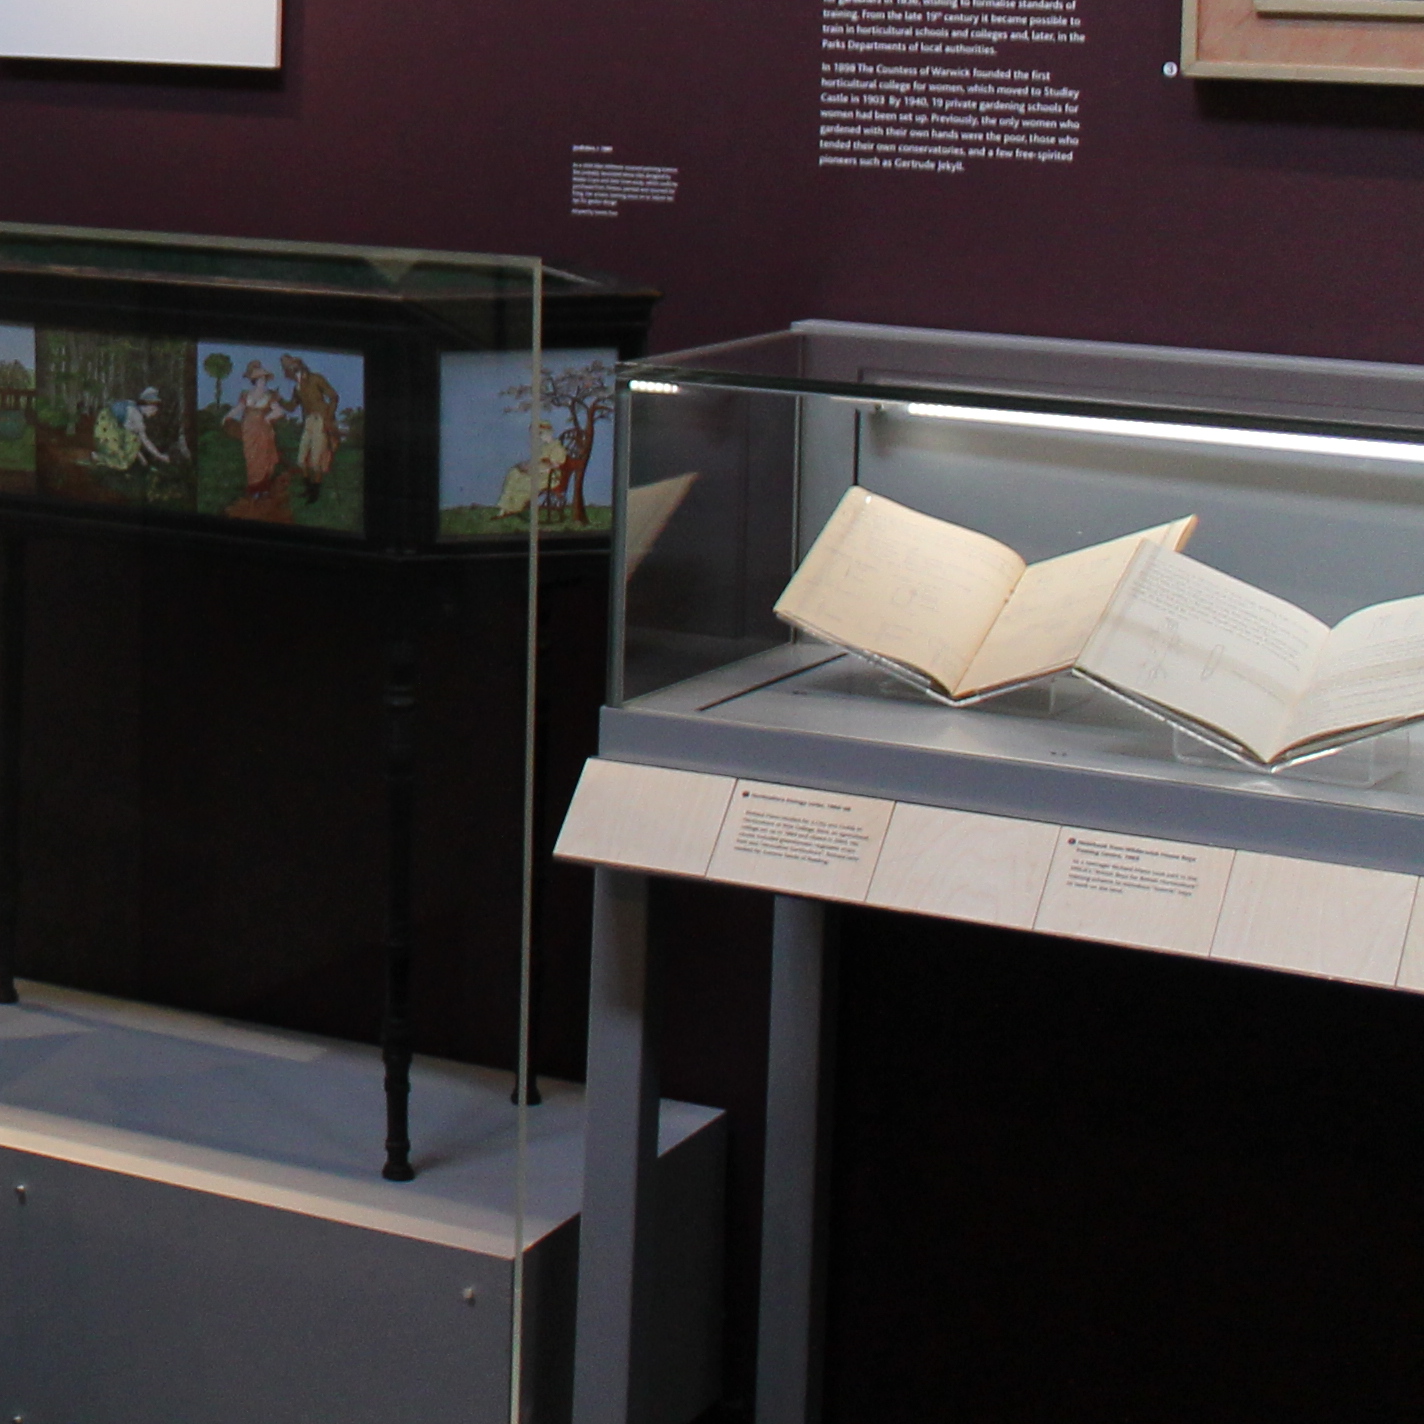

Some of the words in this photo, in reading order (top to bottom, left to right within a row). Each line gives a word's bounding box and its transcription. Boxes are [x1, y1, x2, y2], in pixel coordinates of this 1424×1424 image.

[822, 23, 844, 34] train
[856, 24, 913, 36] horticultural
[915, 26, 949, 37] schools
[951, 27, 969, 38] and
[970, 28, 1008, 42] colleges
[1069, 31, 1085, 41] the
[822, 39, 845, 50] Parks
[847, 40, 906, 54] Departments
[920, 42, 943, 53] local
[821, 78, 877, 89] horticultural
[879, 80, 911, 93] college
[913, 81, 926, 91] for
[967, 83, 995, 93] which
[997, 84, 1029, 95] moved
[1044, 86, 1079, 99] Studley
[820, 125, 861, 139] gardened
[863, 126, 883, 137] with
[886, 127, 907, 138] their
[909, 130, 929, 139] own
[931, 129, 959, 140] hands
[961, 132, 983, 141] were
[986, 131, 1001, 141] the
[1029, 133, 1056, 144] those
[1058, 134, 1079, 145] who
[819, 154, 857, 169] pioneers
[859, 156, 880, 167] such
[894, 158, 935, 170] Gertrude
